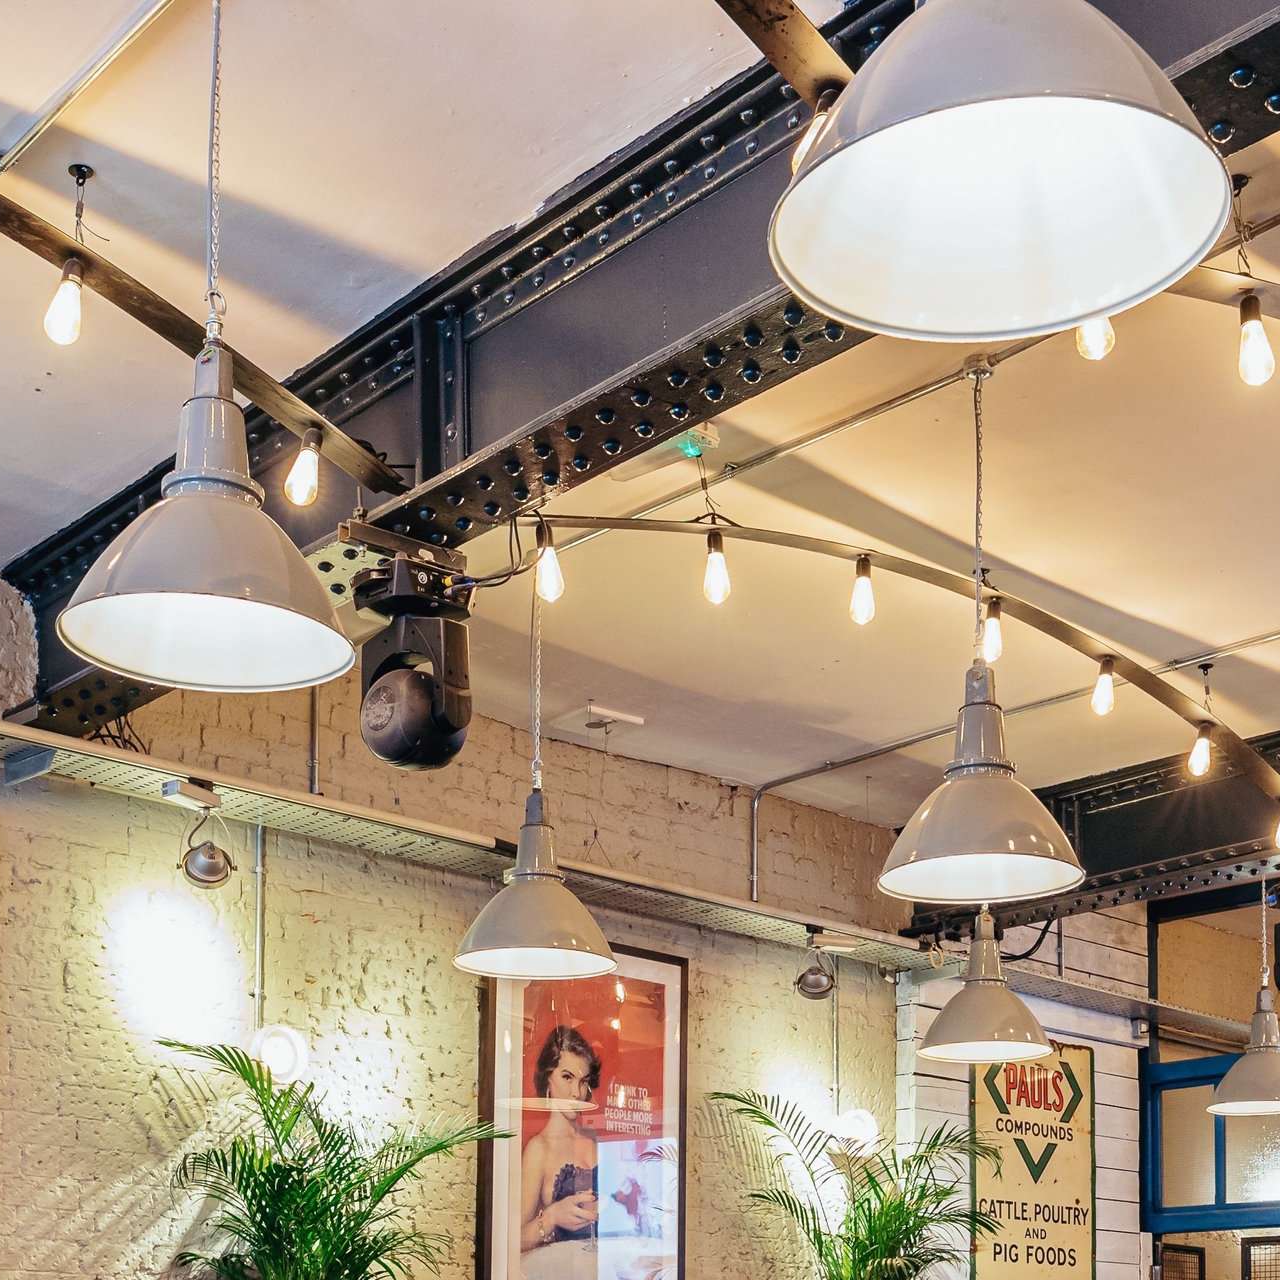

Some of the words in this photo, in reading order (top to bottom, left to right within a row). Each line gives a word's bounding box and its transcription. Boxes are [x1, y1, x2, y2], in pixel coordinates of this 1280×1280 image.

[614, 1083, 637, 1097] DINK
[638, 1087, 649, 1098] TO
[1006, 1062, 1063, 1112] PAULS
[606, 1095, 627, 1108] MAE
[628, 1098, 651, 1112] OTHER
[605, 1107, 632, 1121] PEOPLE
[633, 1111, 653, 1124] MORE
[606, 1120, 651, 1136] INTERESTING
[996, 1118, 1074, 1141] COMPOUNDS
[979, 1198, 1032, 1222] CATTLE,
[1034, 1203, 1089, 1226] POULTRY
[1024, 1227, 1047, 1240] AND
[993, 1243, 1019, 1263] PIG
[1026, 1245, 1076, 1267] FOODS
